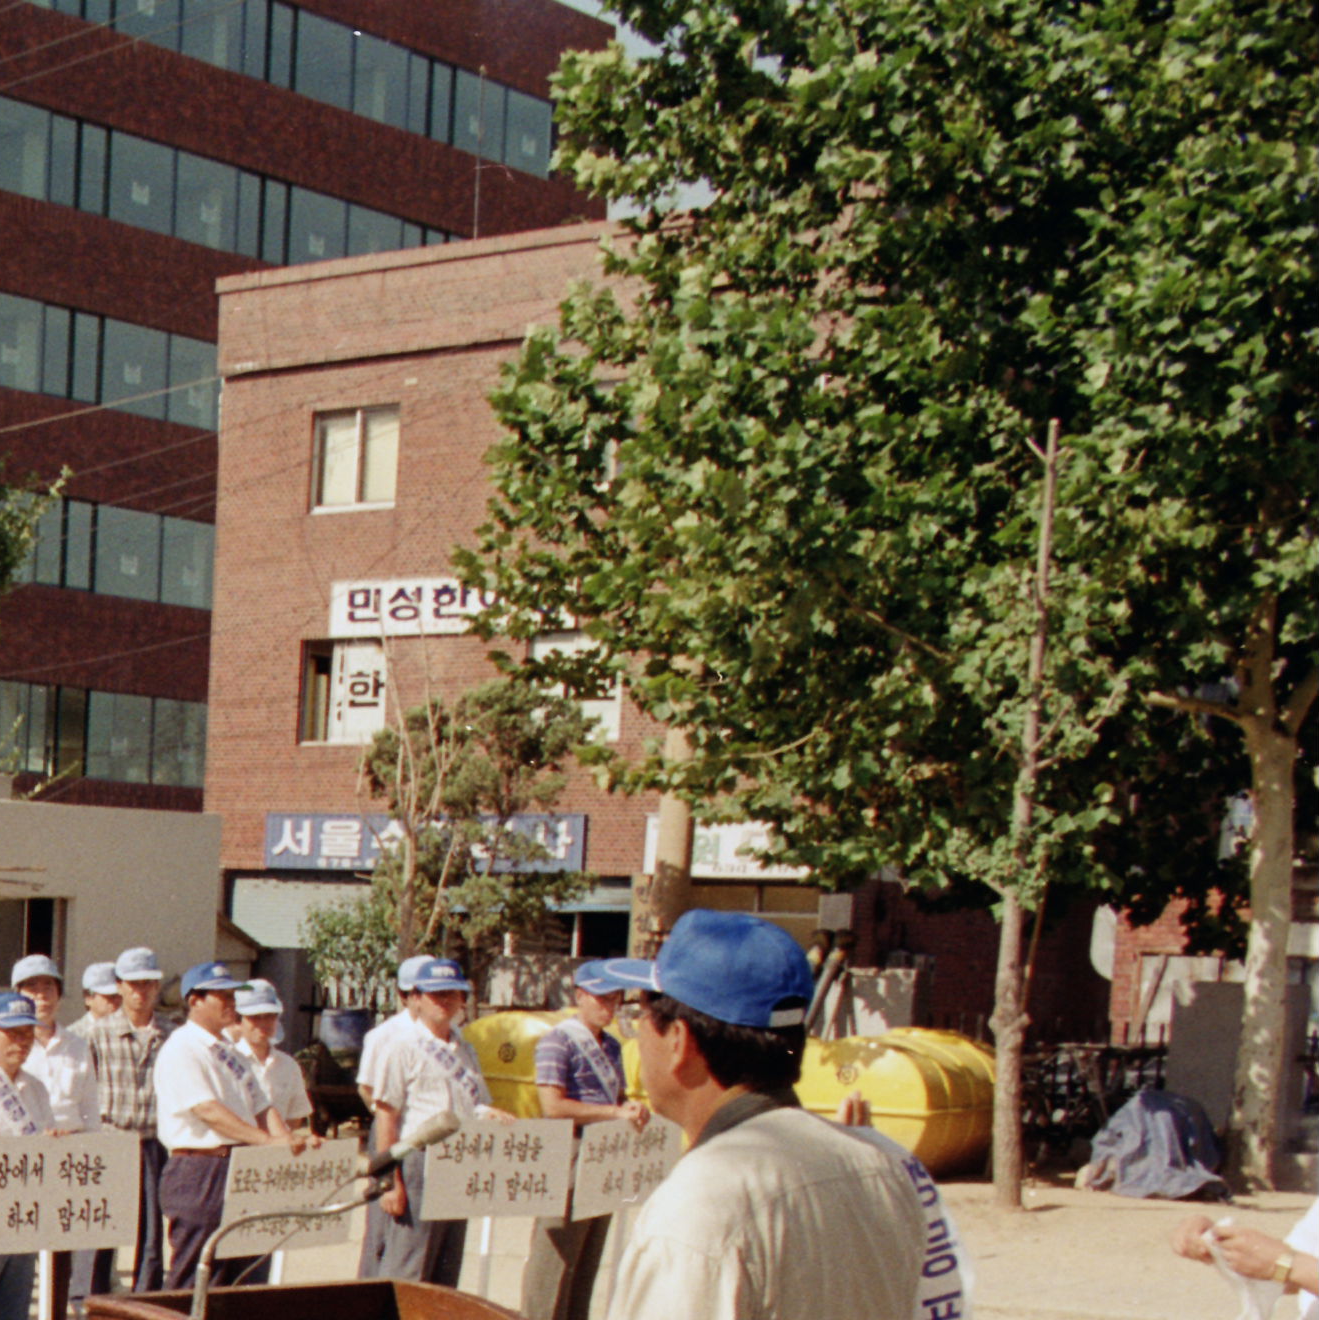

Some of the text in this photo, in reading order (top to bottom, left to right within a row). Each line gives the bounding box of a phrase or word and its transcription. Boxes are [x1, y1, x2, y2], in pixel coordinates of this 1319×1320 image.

[436, 1132, 543, 1164] 노상에서 작업을
[58, 1152, 107, 1187] 작업을
[465, 1171, 496, 1202] 하지
[6, 1200, 40, 1233] 하지
